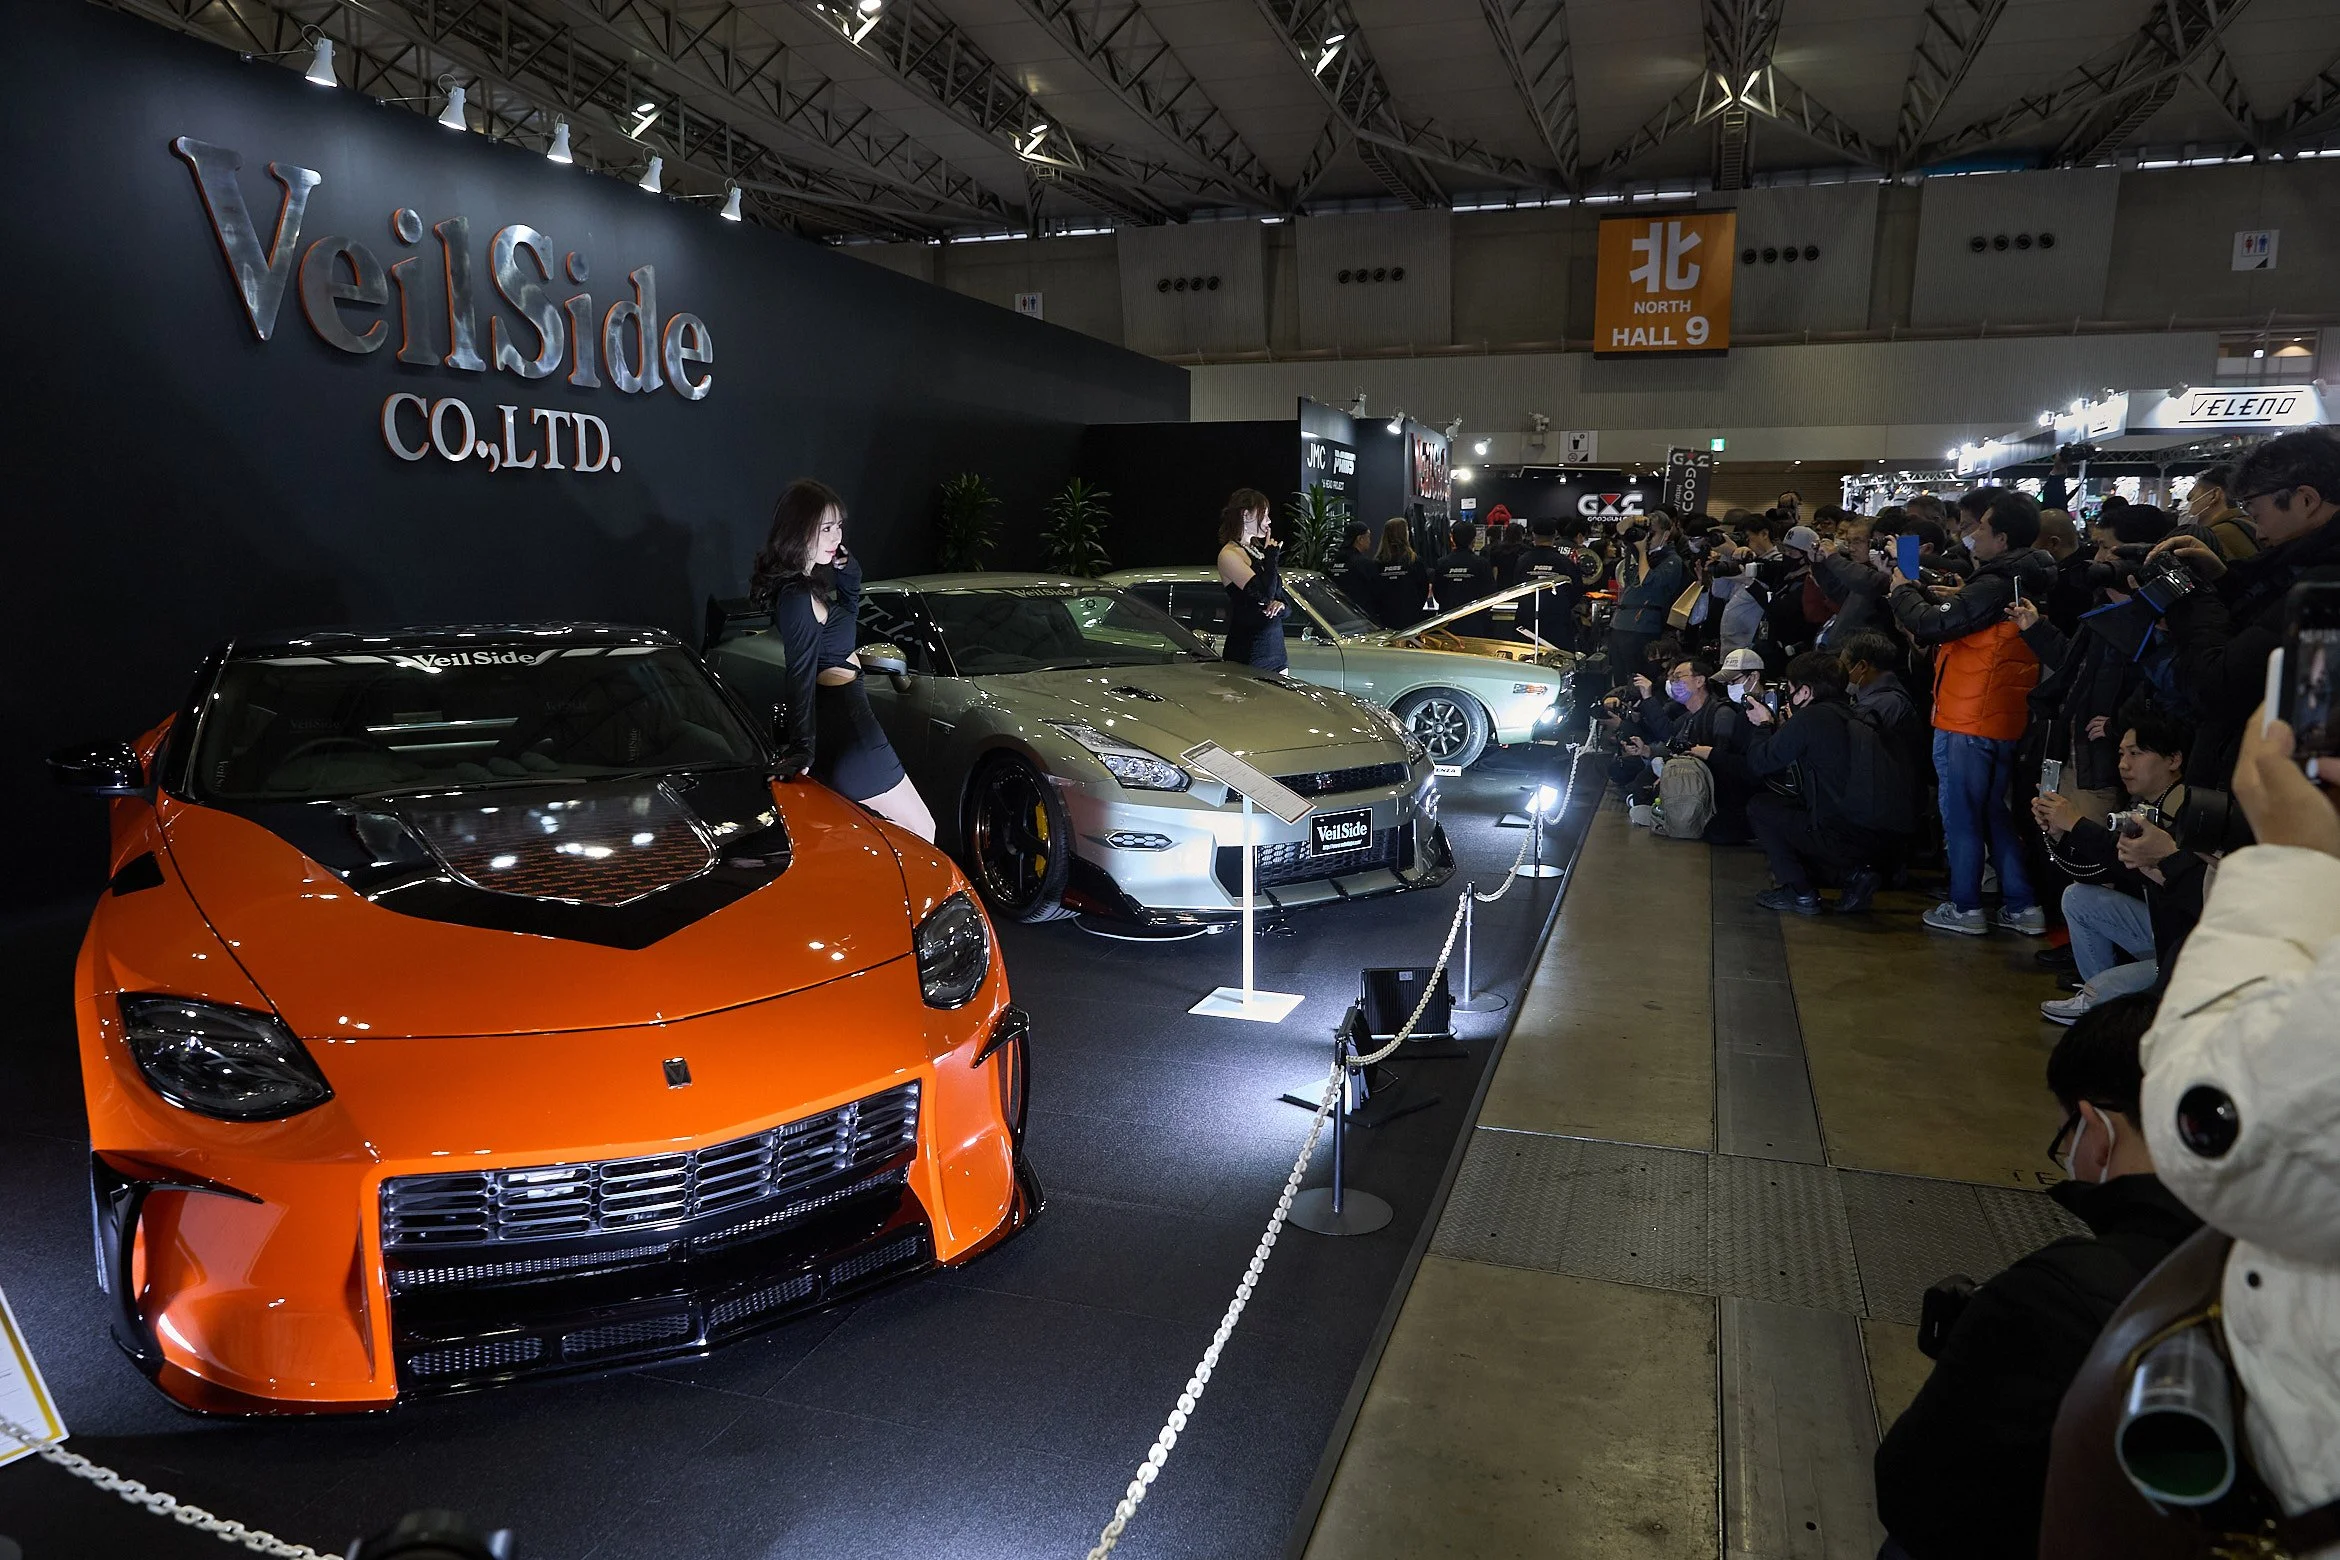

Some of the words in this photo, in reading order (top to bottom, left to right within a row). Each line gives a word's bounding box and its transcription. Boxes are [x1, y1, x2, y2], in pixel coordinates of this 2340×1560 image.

[1629, 221, 1702, 293] 北
[168, 136, 714, 402] VeilSide
[1633, 300, 1692, 315] NORTH
[1612, 326, 1677, 347] HALL
[1685, 315, 1710, 346] 9
[2190, 395, 2297, 417] VELENO
[1306, 442, 1327, 470] JMC
[1016, 588, 1075, 598] VeilSide
[413, 650, 535, 668] VeilSide
[1316, 820, 1368, 842] VeilSide
